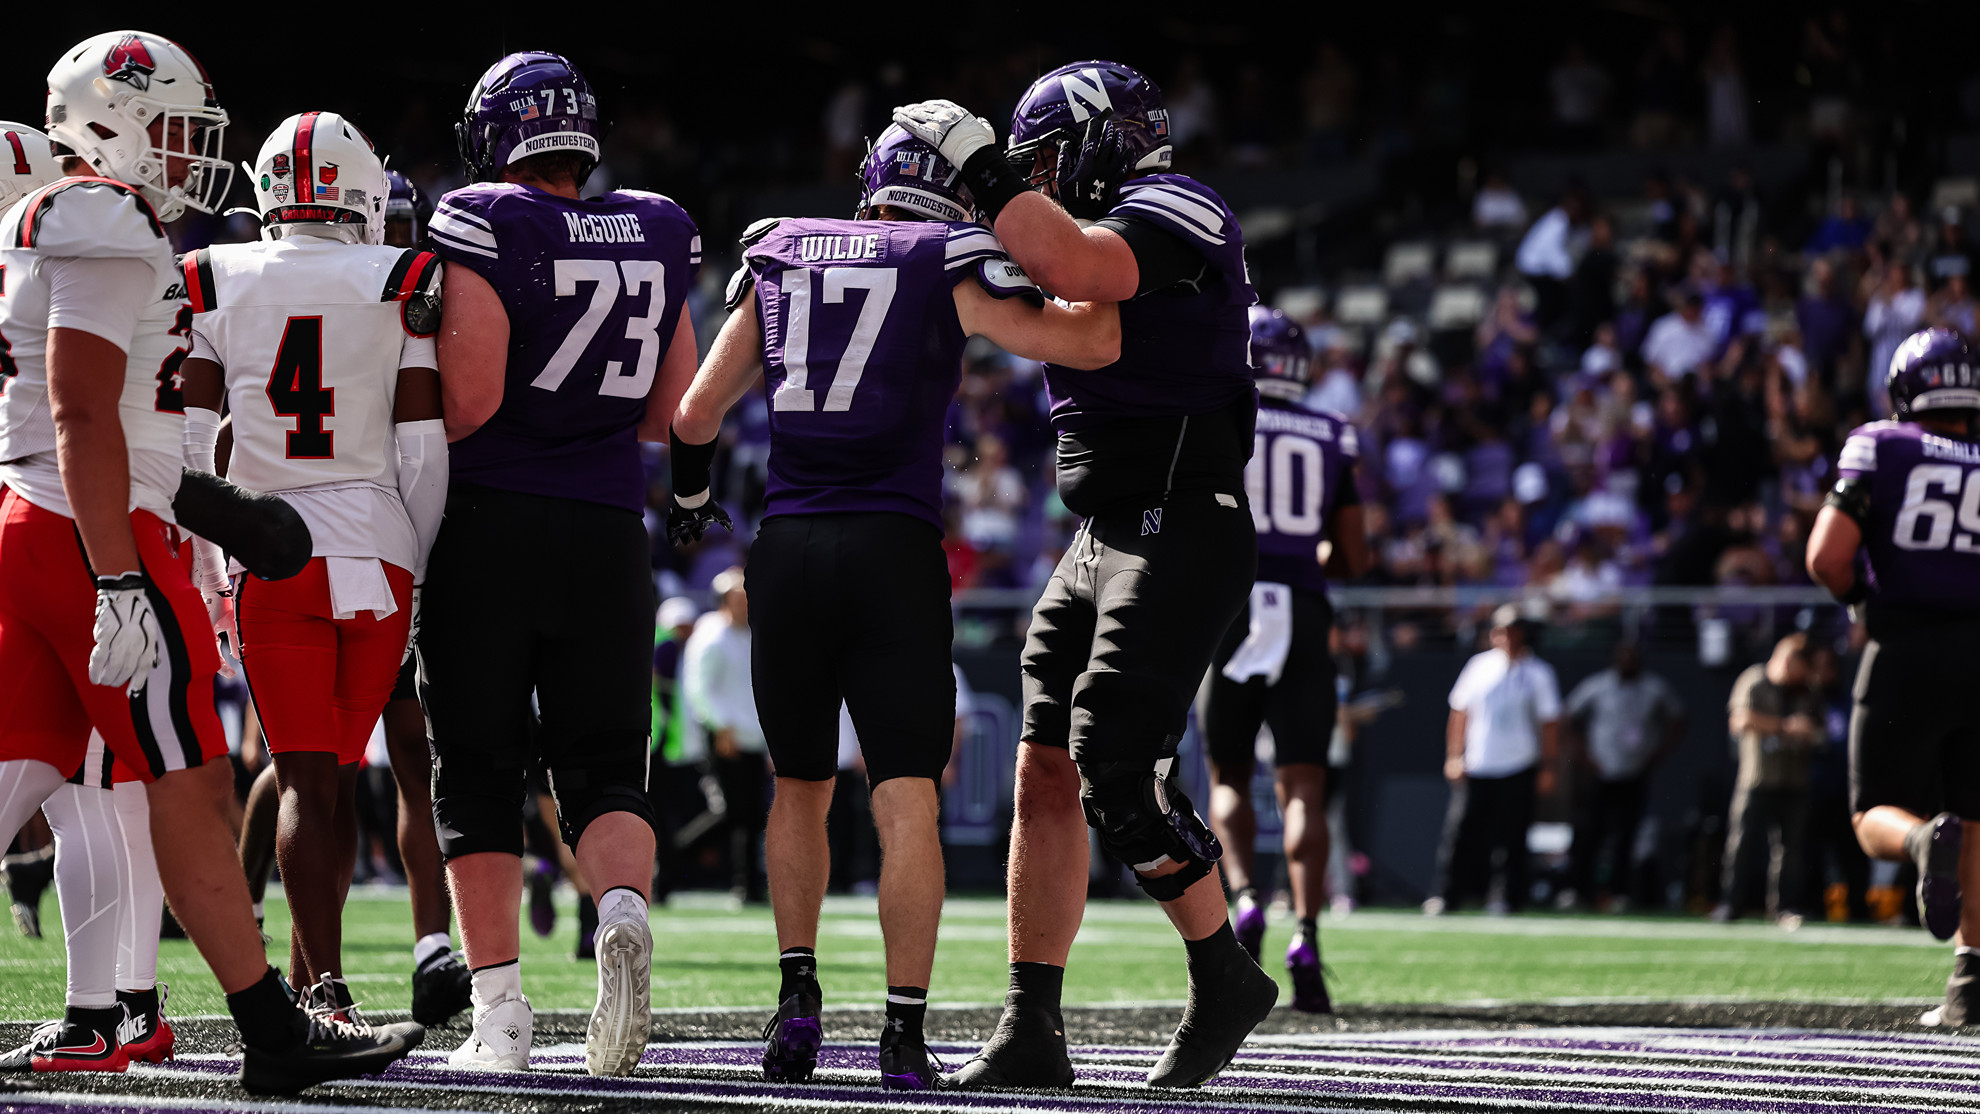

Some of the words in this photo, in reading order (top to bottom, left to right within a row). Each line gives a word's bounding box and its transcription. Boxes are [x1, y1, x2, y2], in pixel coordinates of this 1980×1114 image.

[509, 95, 538, 112] W.I.N.
[540, 88, 578, 116] 73
[1060, 68, 1114, 123] N
[4, 131, 31, 175] 1
[525, 135, 596, 153] NORTHWESTERN
[281, 208, 335, 221] CARDINALS
[886, 190, 966, 221] NORTHWESTERN
[562, 211, 645, 243] McGUIRE
[801, 234, 879, 262] WILDE
[530, 259, 666, 399] 73
[773, 268, 898, 411] 17
[265, 315, 335, 459] 4
[1141, 508, 1162, 536] N
[119, 1012, 148, 1047] NIKE
